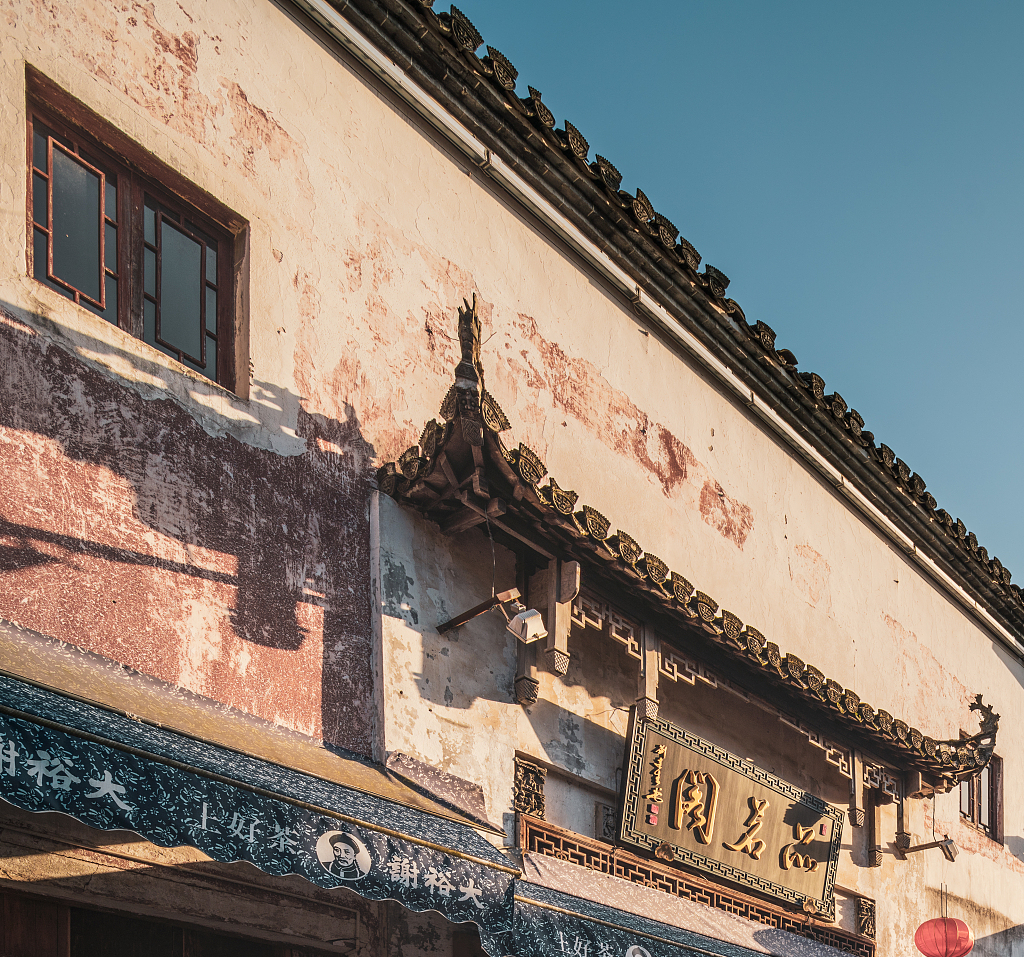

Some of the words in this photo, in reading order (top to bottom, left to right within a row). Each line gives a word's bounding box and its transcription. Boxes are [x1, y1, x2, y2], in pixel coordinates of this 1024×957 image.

[200, 802, 299, 855] 上好茶
[386, 855, 486, 910] 謝裕大
